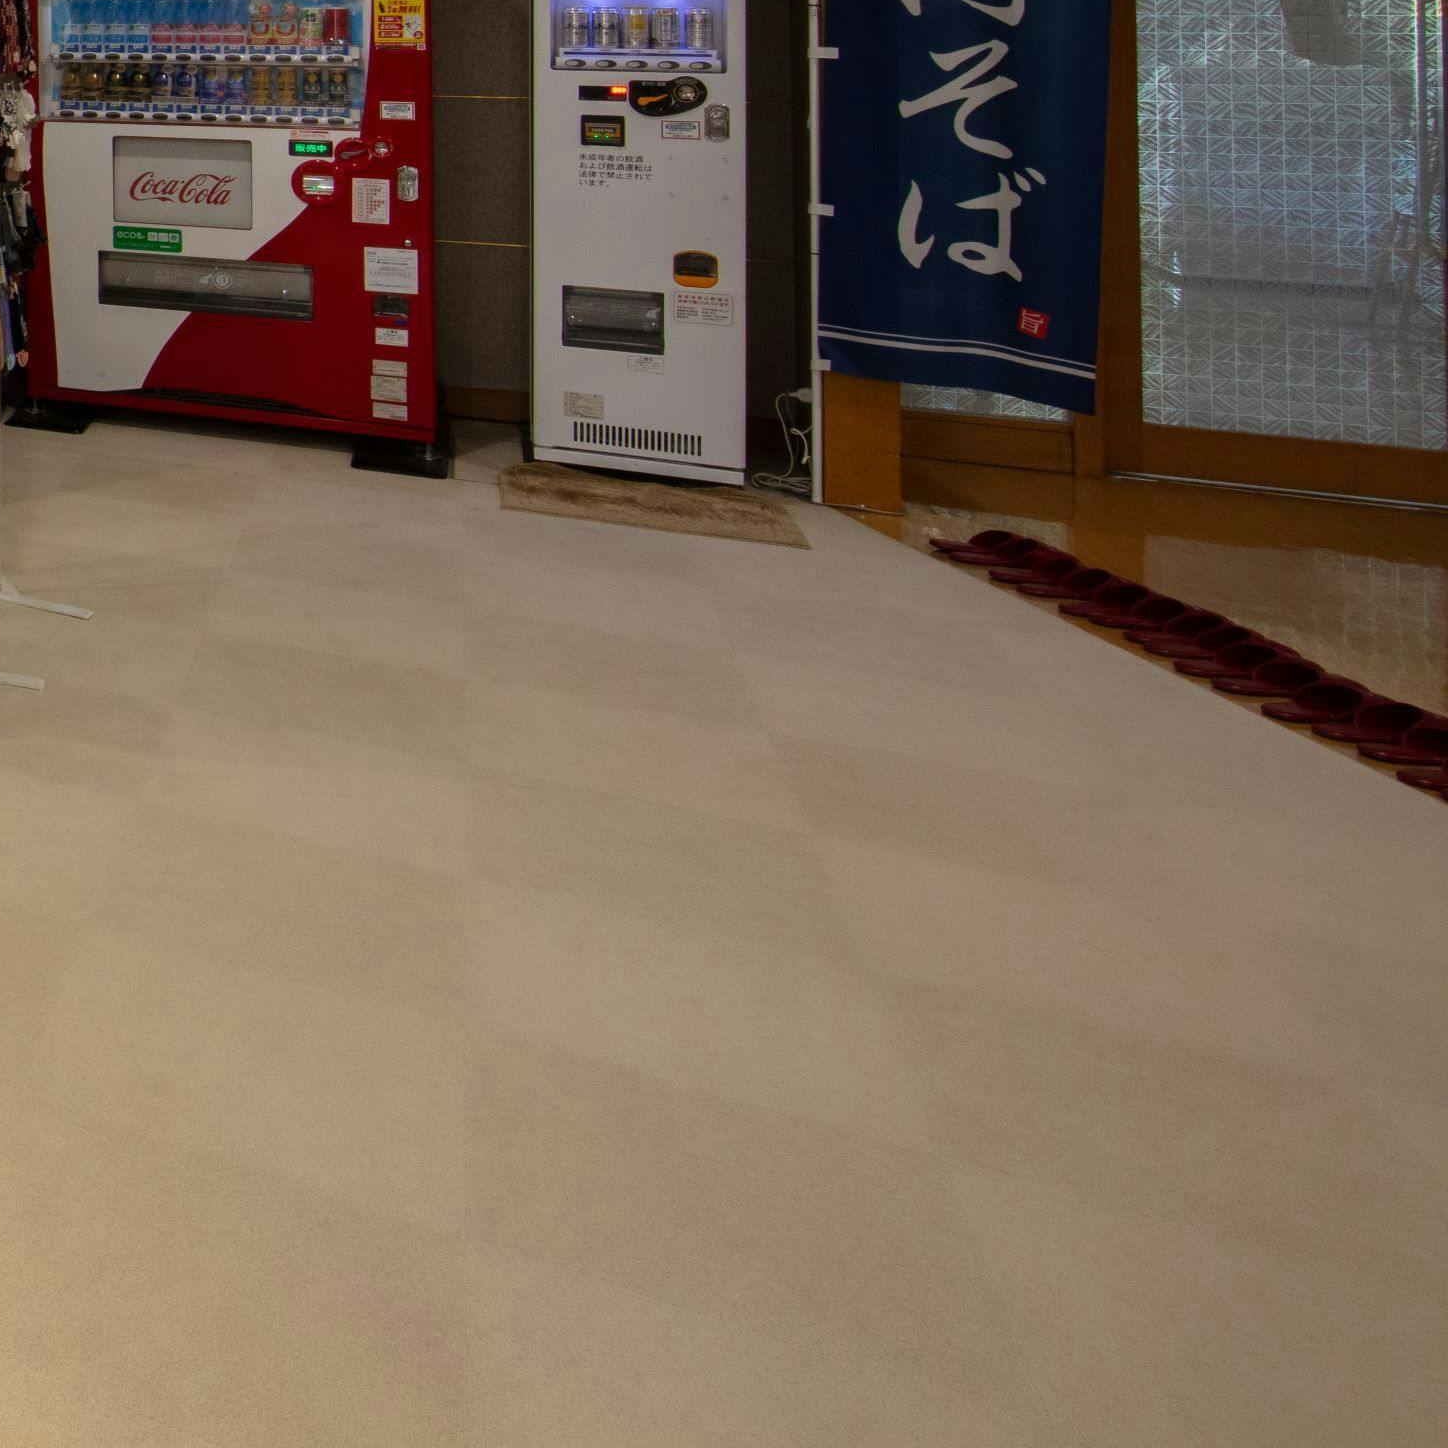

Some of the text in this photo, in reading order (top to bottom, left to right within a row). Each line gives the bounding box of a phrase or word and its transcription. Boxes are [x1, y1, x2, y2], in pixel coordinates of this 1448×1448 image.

[294, 143, 327, 154] 販売中
[578, 153, 644, 163] 未成年者の飲酒
[578, 162, 653, 172] および飲酒運転は
[578, 171, 653, 181] 法律で禁止されて
[129, 172, 238, 206] Coca-Cola
